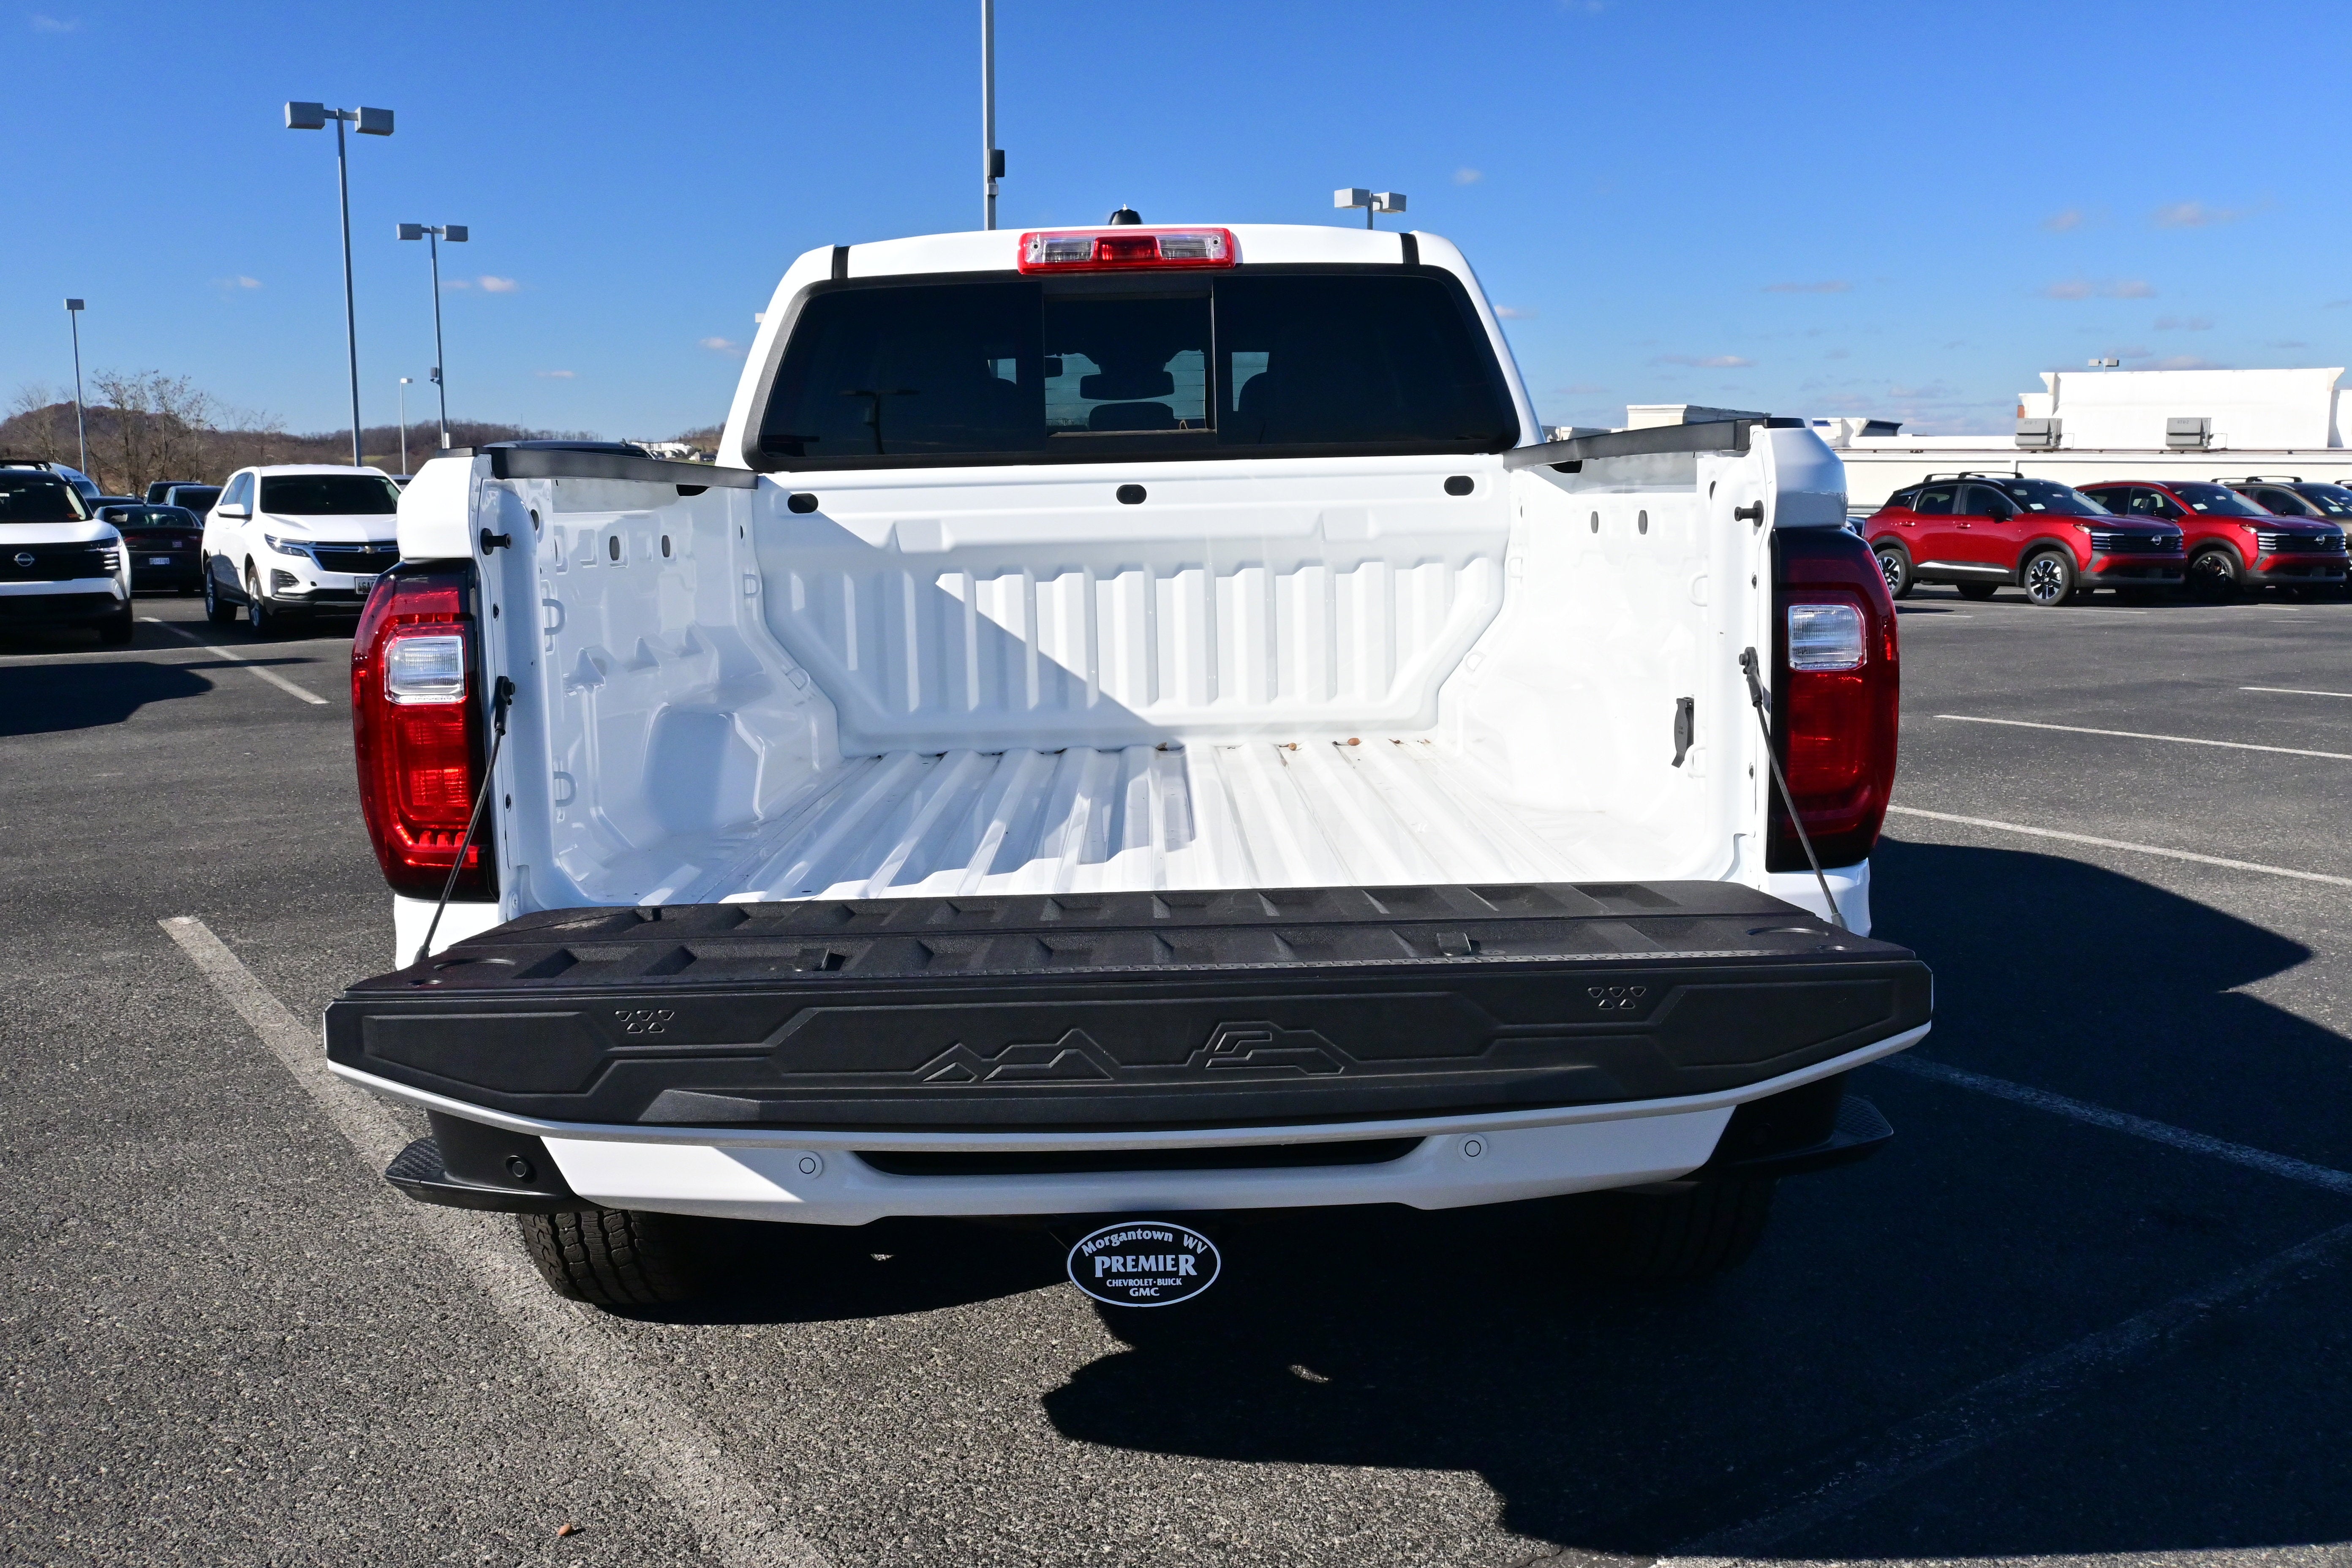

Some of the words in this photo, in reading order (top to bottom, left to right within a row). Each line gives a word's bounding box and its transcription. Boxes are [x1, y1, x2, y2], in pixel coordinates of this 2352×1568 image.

[1081, 1228, 1173, 1256] Morgantown
[1183, 1234, 1208, 1254] WV
[1094, 1254, 1198, 1277] PREMIER
[1107, 1279, 1153, 1287] CHEVROLET
[1130, 1288, 1160, 1296] GMC
